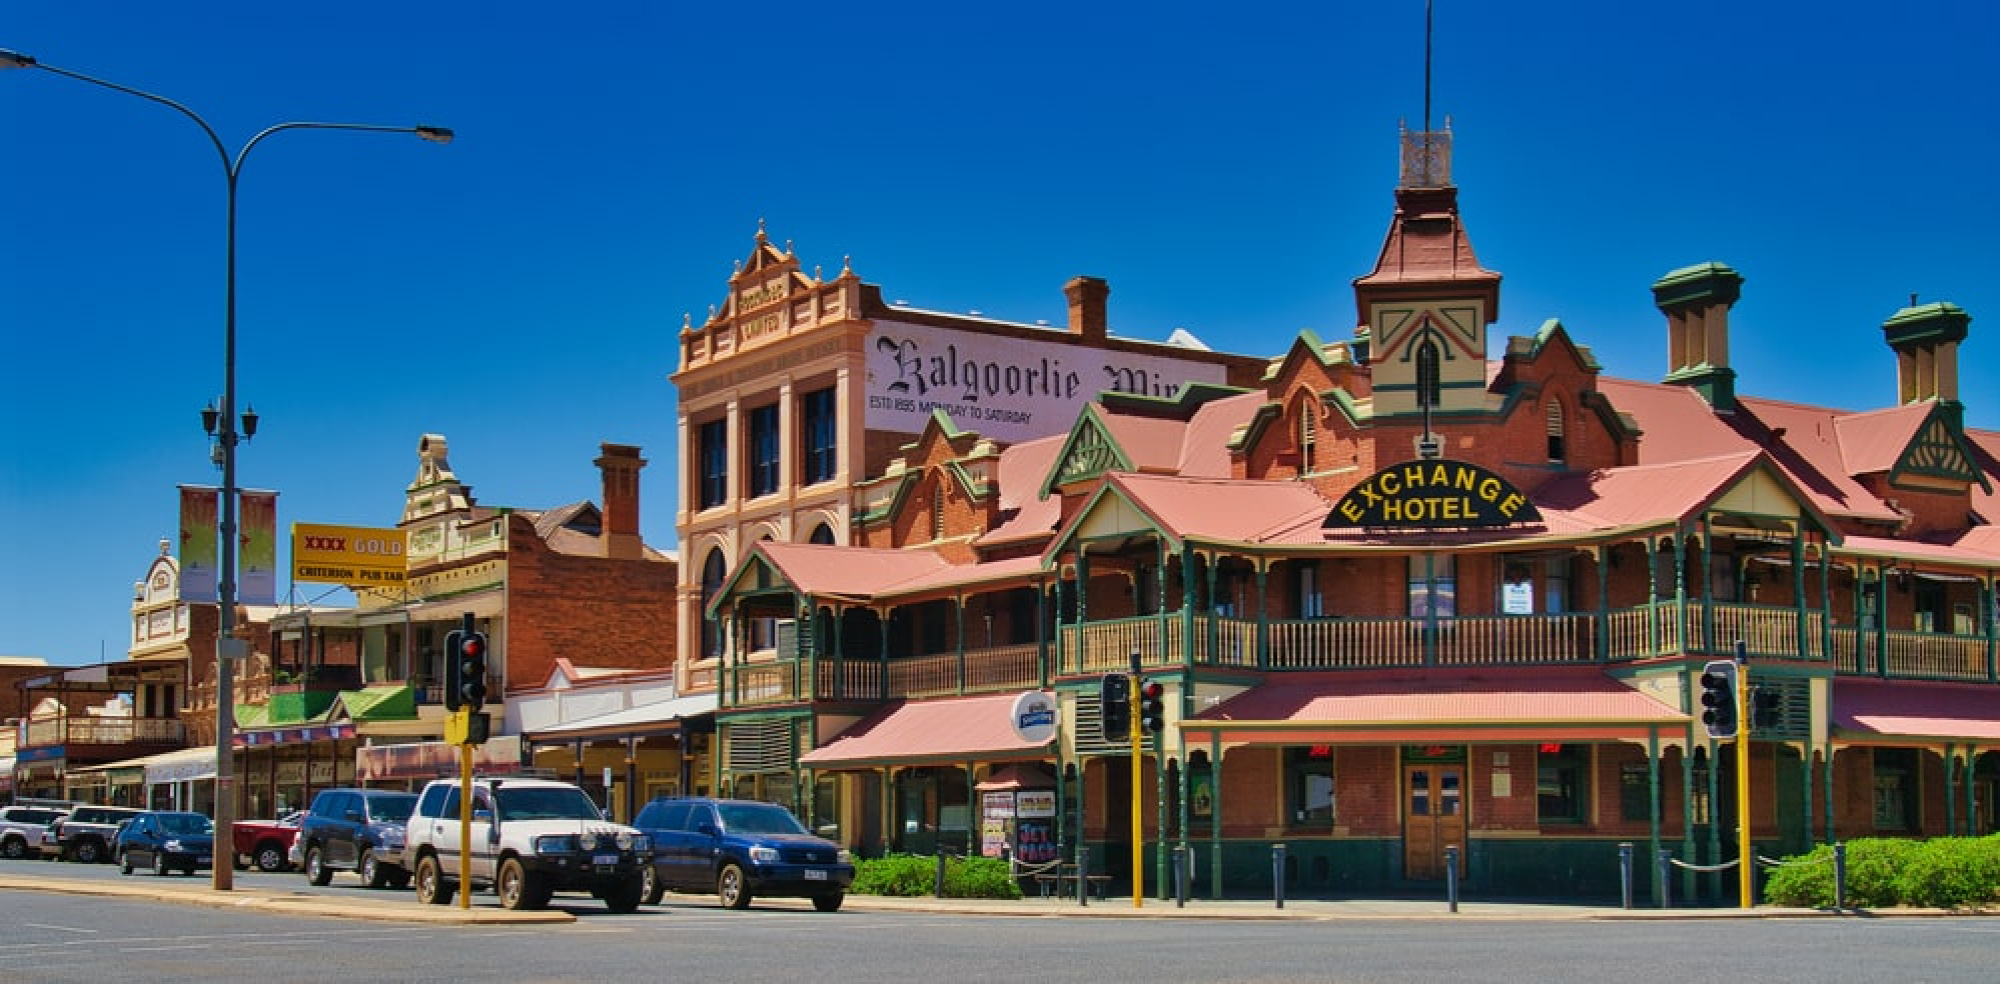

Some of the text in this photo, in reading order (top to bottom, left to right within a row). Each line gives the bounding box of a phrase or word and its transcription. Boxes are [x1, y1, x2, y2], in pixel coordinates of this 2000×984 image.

[877, 336, 1080, 402] Kalgoorlie
[1103, 365, 1180, 397] Min
[971, 406, 982, 418] TO
[985, 407, 1032, 424] SATURDAY
[1340, 464, 1527, 523] EXCHANGE
[1383, 497, 1480, 521] HOTEL
[304, 535, 346, 551] XXXX
[353, 539, 402, 555] GOLD
[299, 566, 353, 579] CRITERION
[360, 569, 382, 580] PUB
